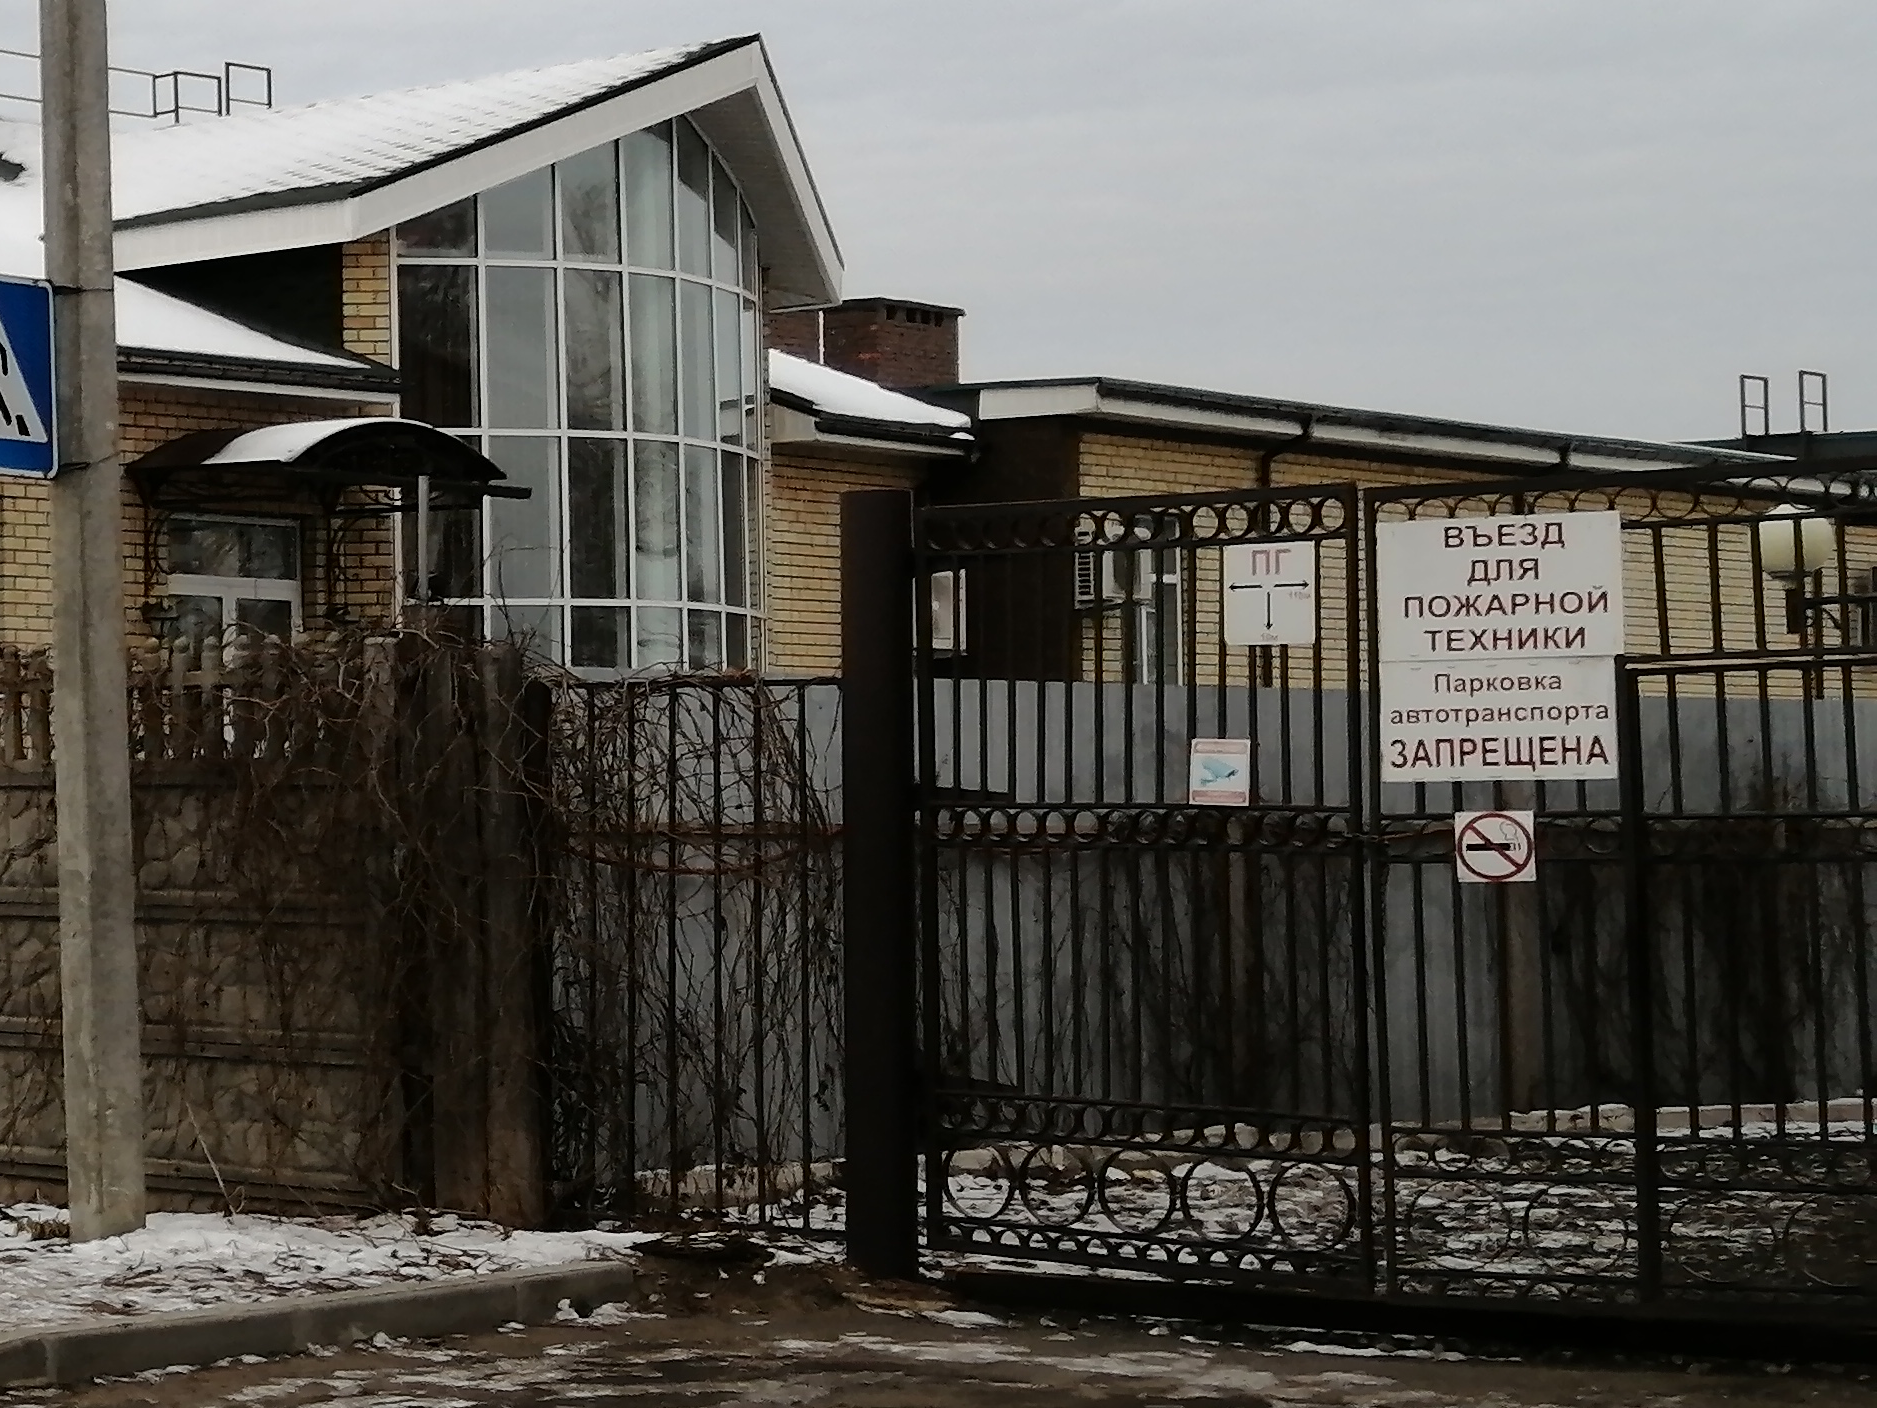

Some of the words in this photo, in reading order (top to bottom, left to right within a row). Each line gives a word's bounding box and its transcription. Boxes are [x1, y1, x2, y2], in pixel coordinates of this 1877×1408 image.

[1443, 521, 1566, 550] ВЪЕЗД
[1251, 548, 1292, 576] ПГ
[1466, 557, 1540, 587] ДЛЯ
[1403, 585, 1609, 619] ПОЖАРНОЙ
[1423, 626, 1587, 652] ТЕХНИКИ
[1433, 673, 1563, 698] Парковка
[1389, 703, 1610, 728] автотранспорта
[1389, 735, 1610, 772] ЗАПРЕЩЕНА
